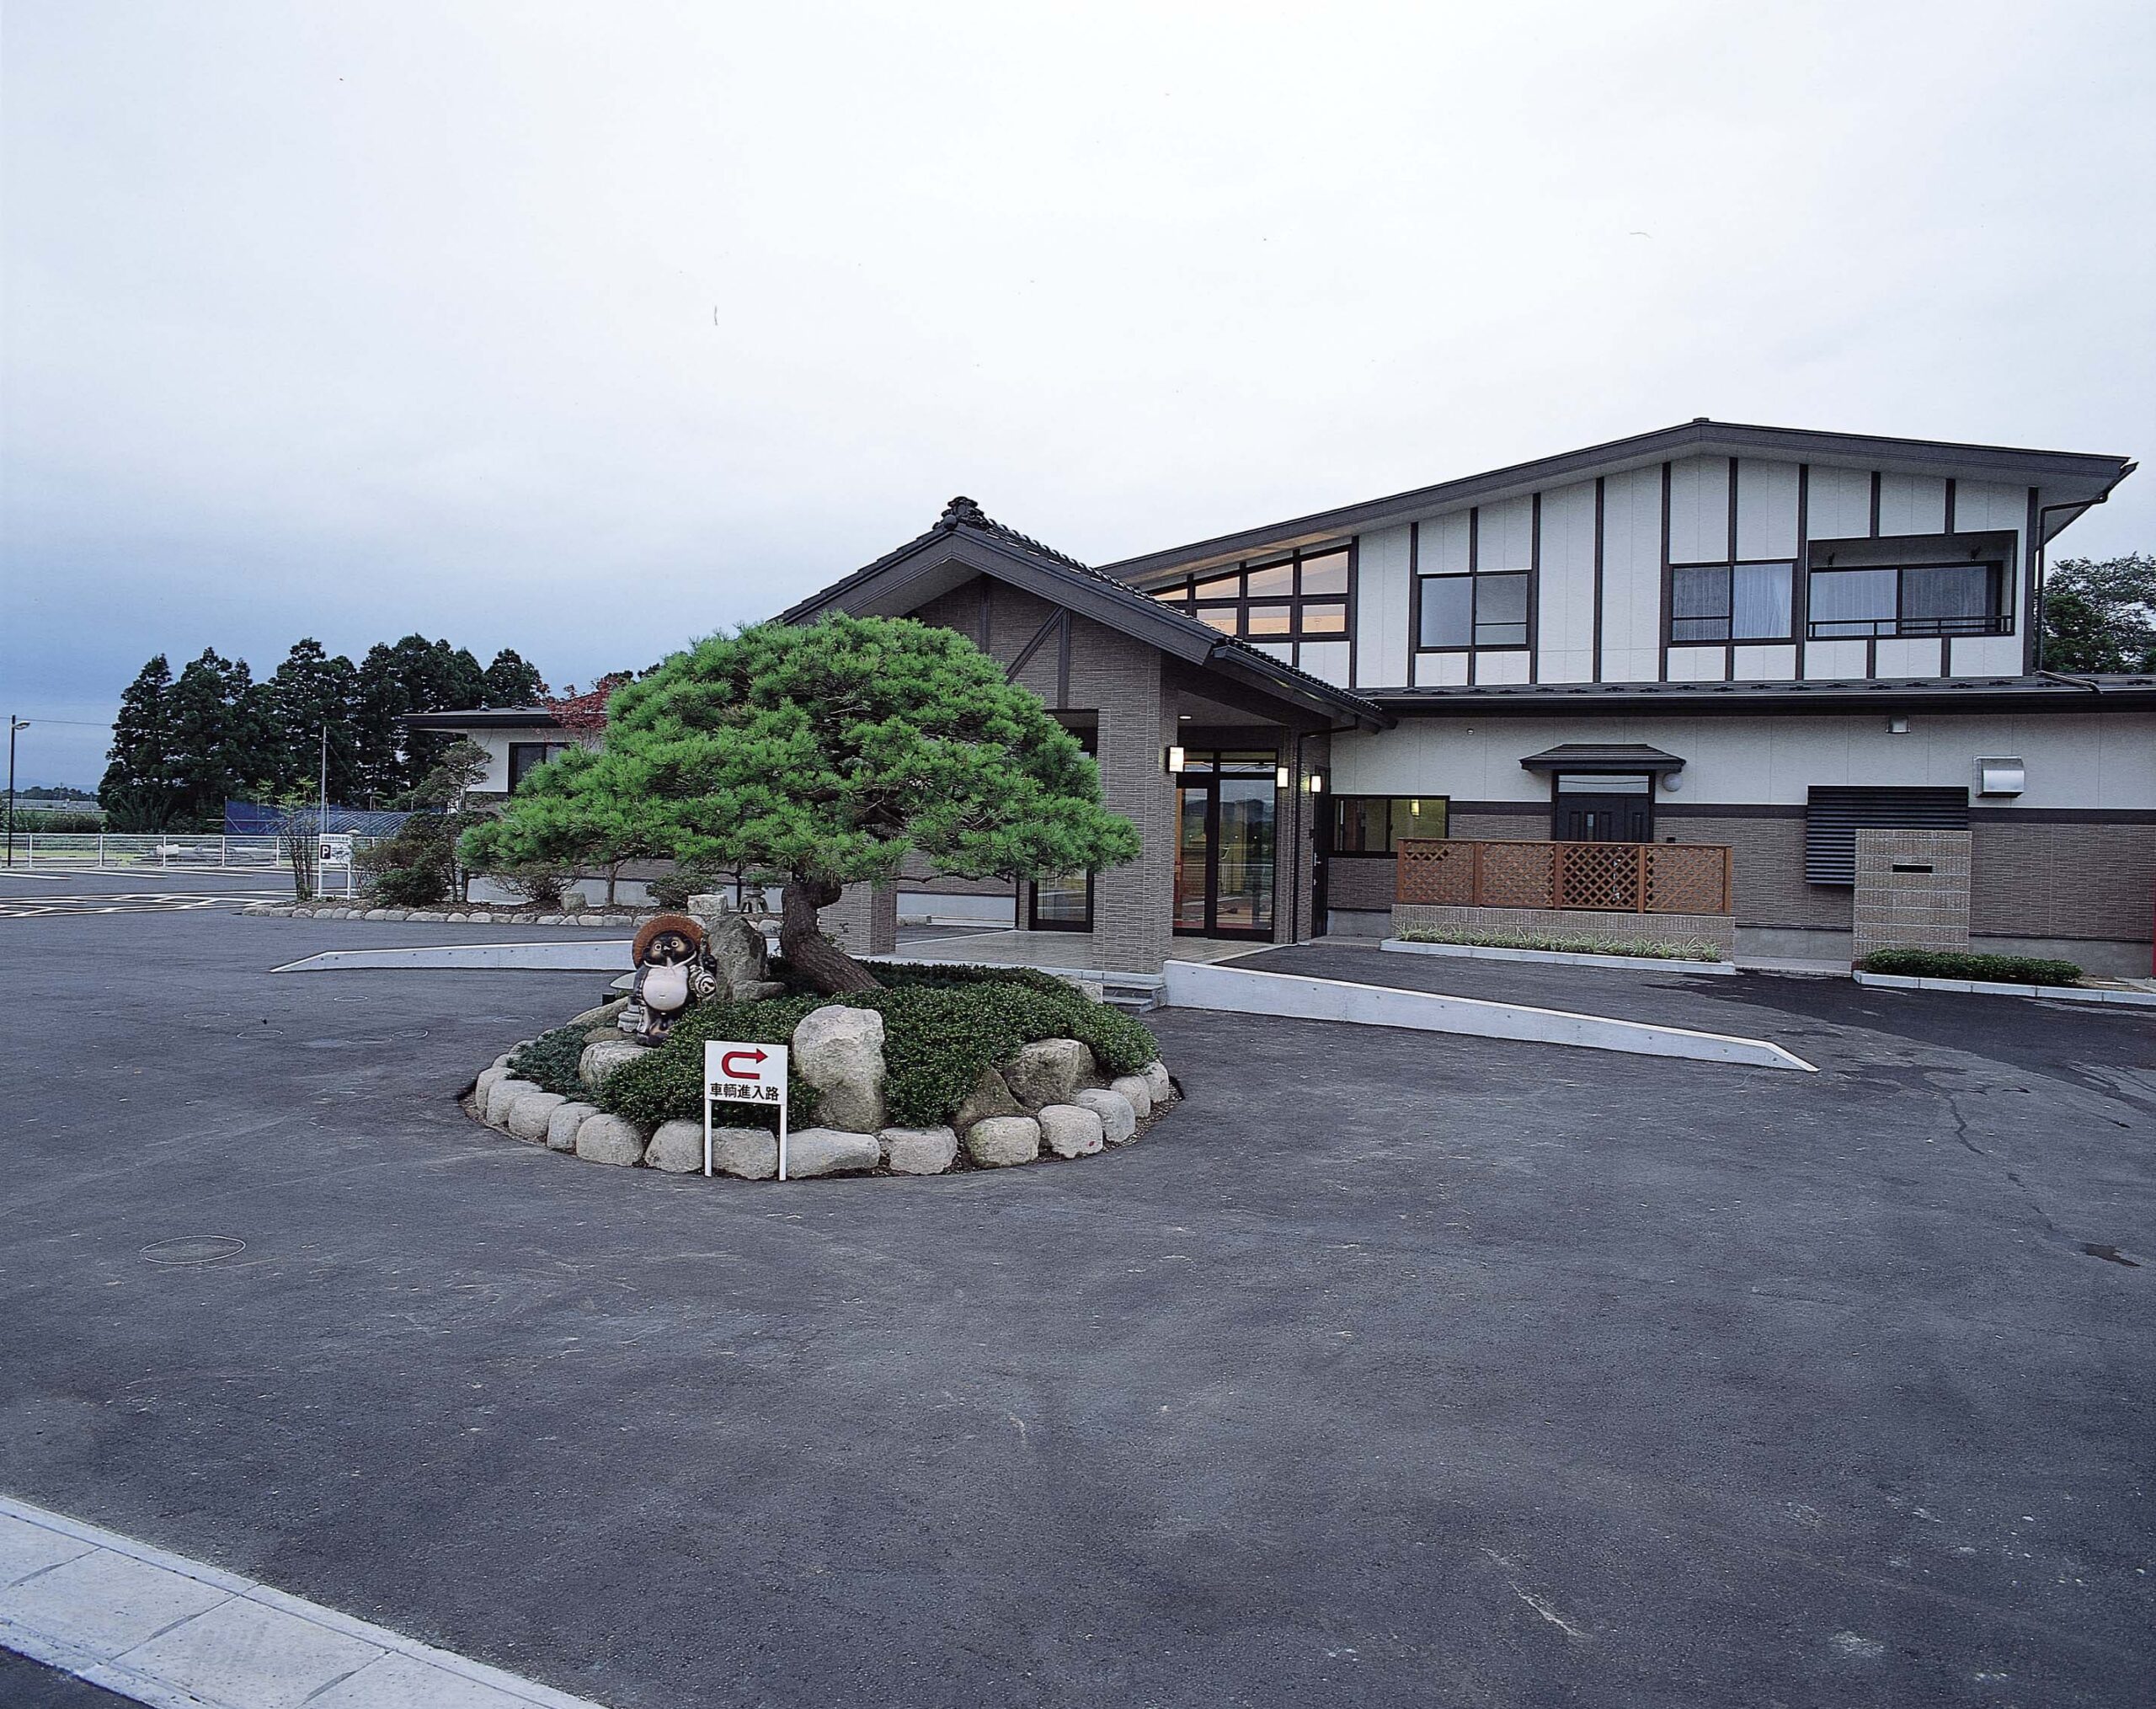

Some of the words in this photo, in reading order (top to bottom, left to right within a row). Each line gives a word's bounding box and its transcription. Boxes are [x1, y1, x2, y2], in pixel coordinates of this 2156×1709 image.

[322, 846, 329, 858] P
[710, 1082, 779, 1101] 車輌進入路
